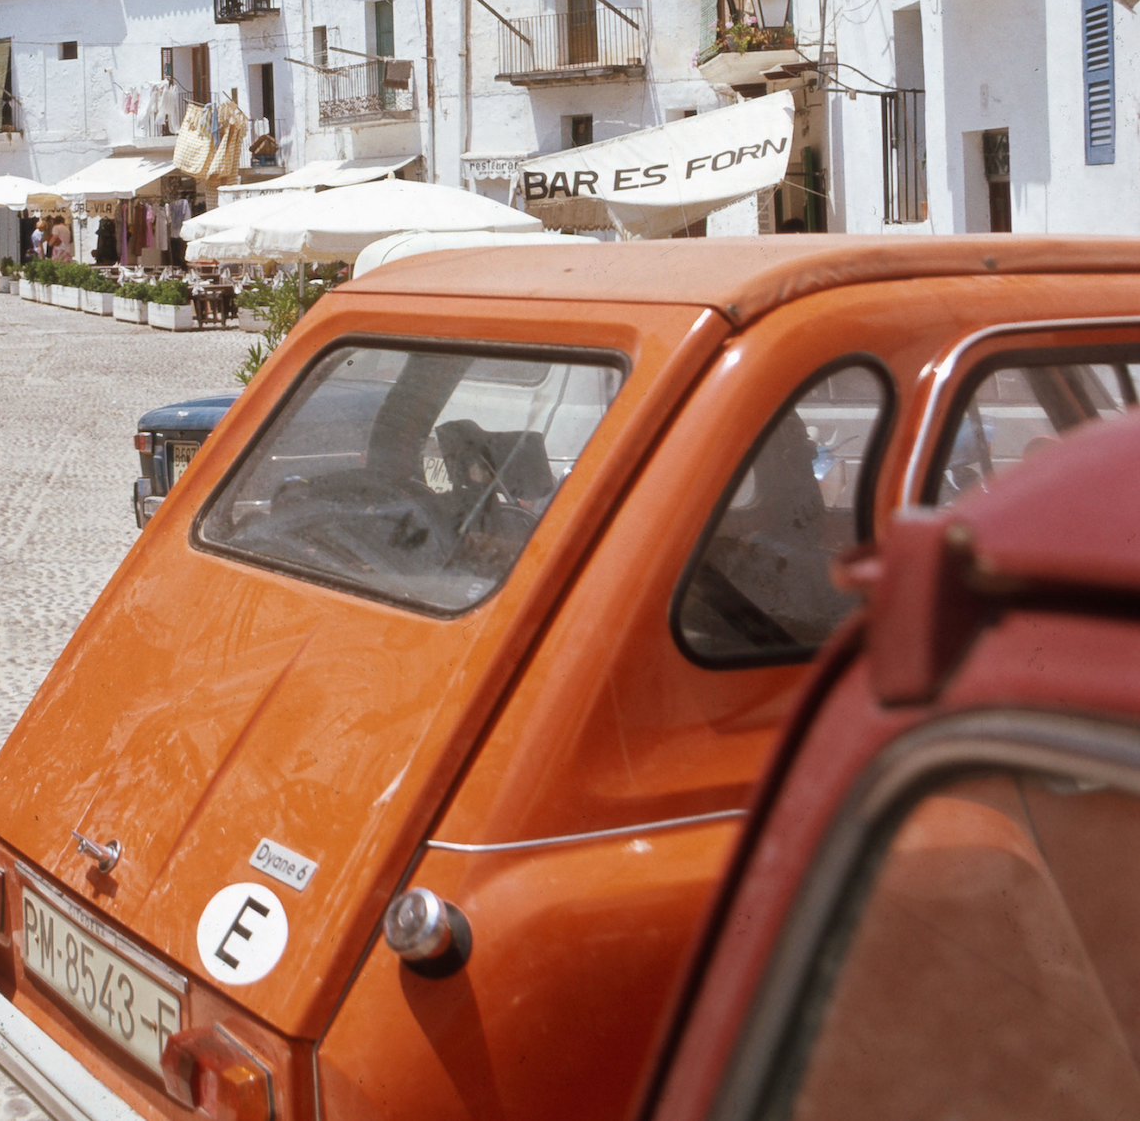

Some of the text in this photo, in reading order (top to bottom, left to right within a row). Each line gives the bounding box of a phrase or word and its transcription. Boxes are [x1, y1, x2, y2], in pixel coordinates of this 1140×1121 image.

[523, 137, 788, 201] BAR ES FORN
[256, 843, 309, 881] Dyane 6
[213, 895, 271, 971] E
